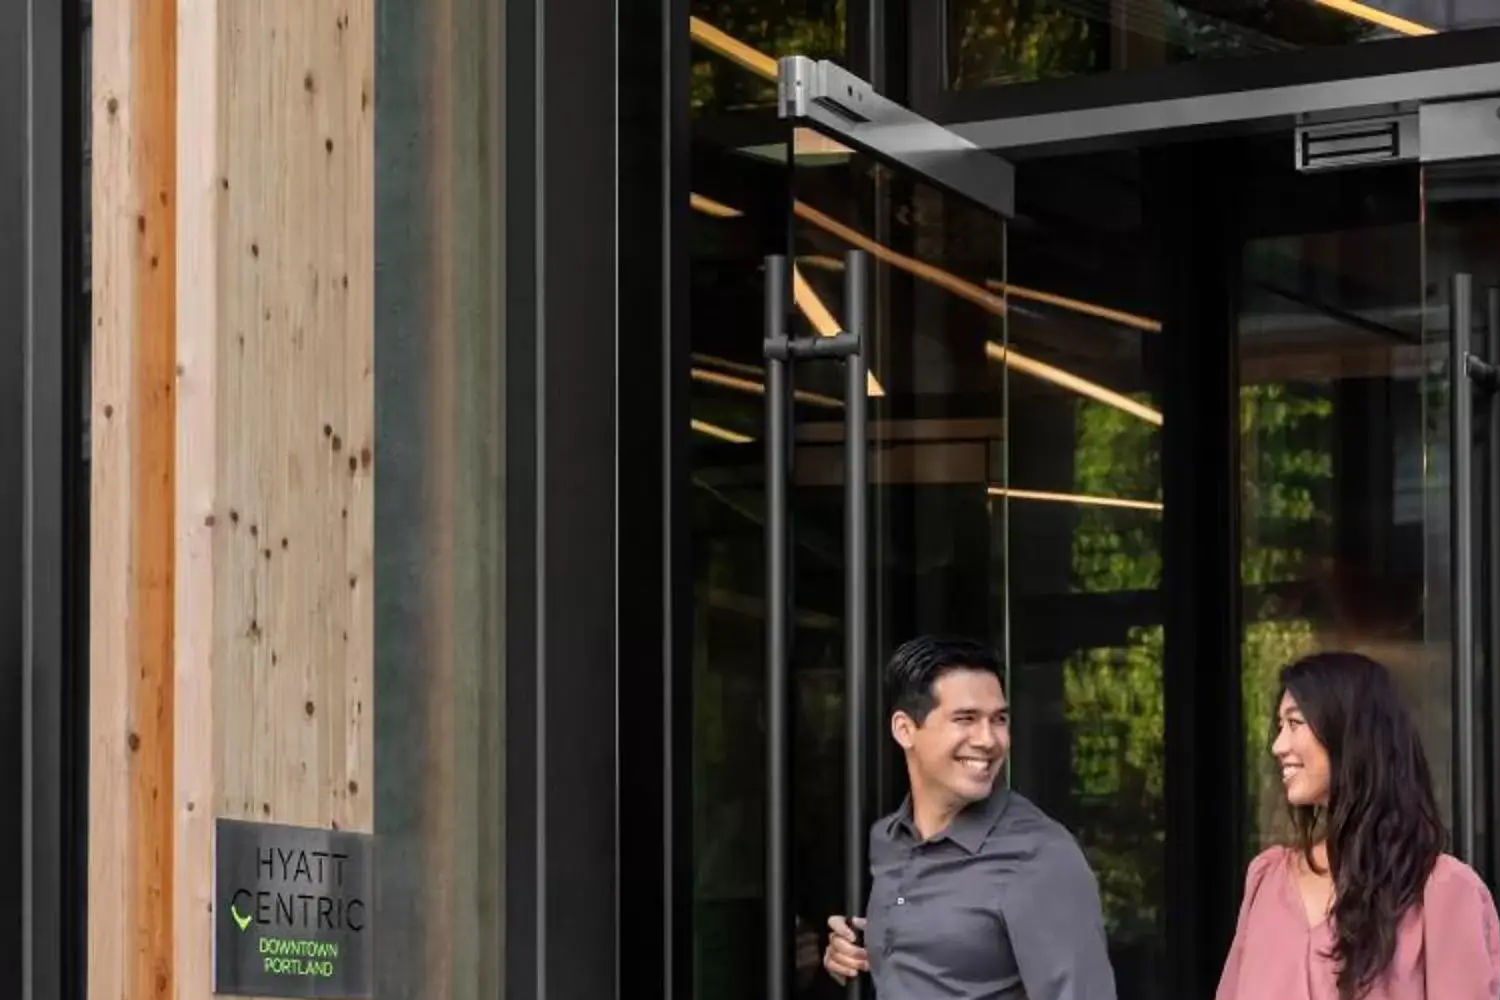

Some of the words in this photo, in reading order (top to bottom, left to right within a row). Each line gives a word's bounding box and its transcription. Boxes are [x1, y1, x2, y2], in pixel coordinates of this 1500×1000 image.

[256, 847, 349, 886] HYATT
[231, 888, 365, 932] CENTRIC
[259, 938, 339, 959] DOWNTOWN
[264, 957, 334, 977] PORTLAND
